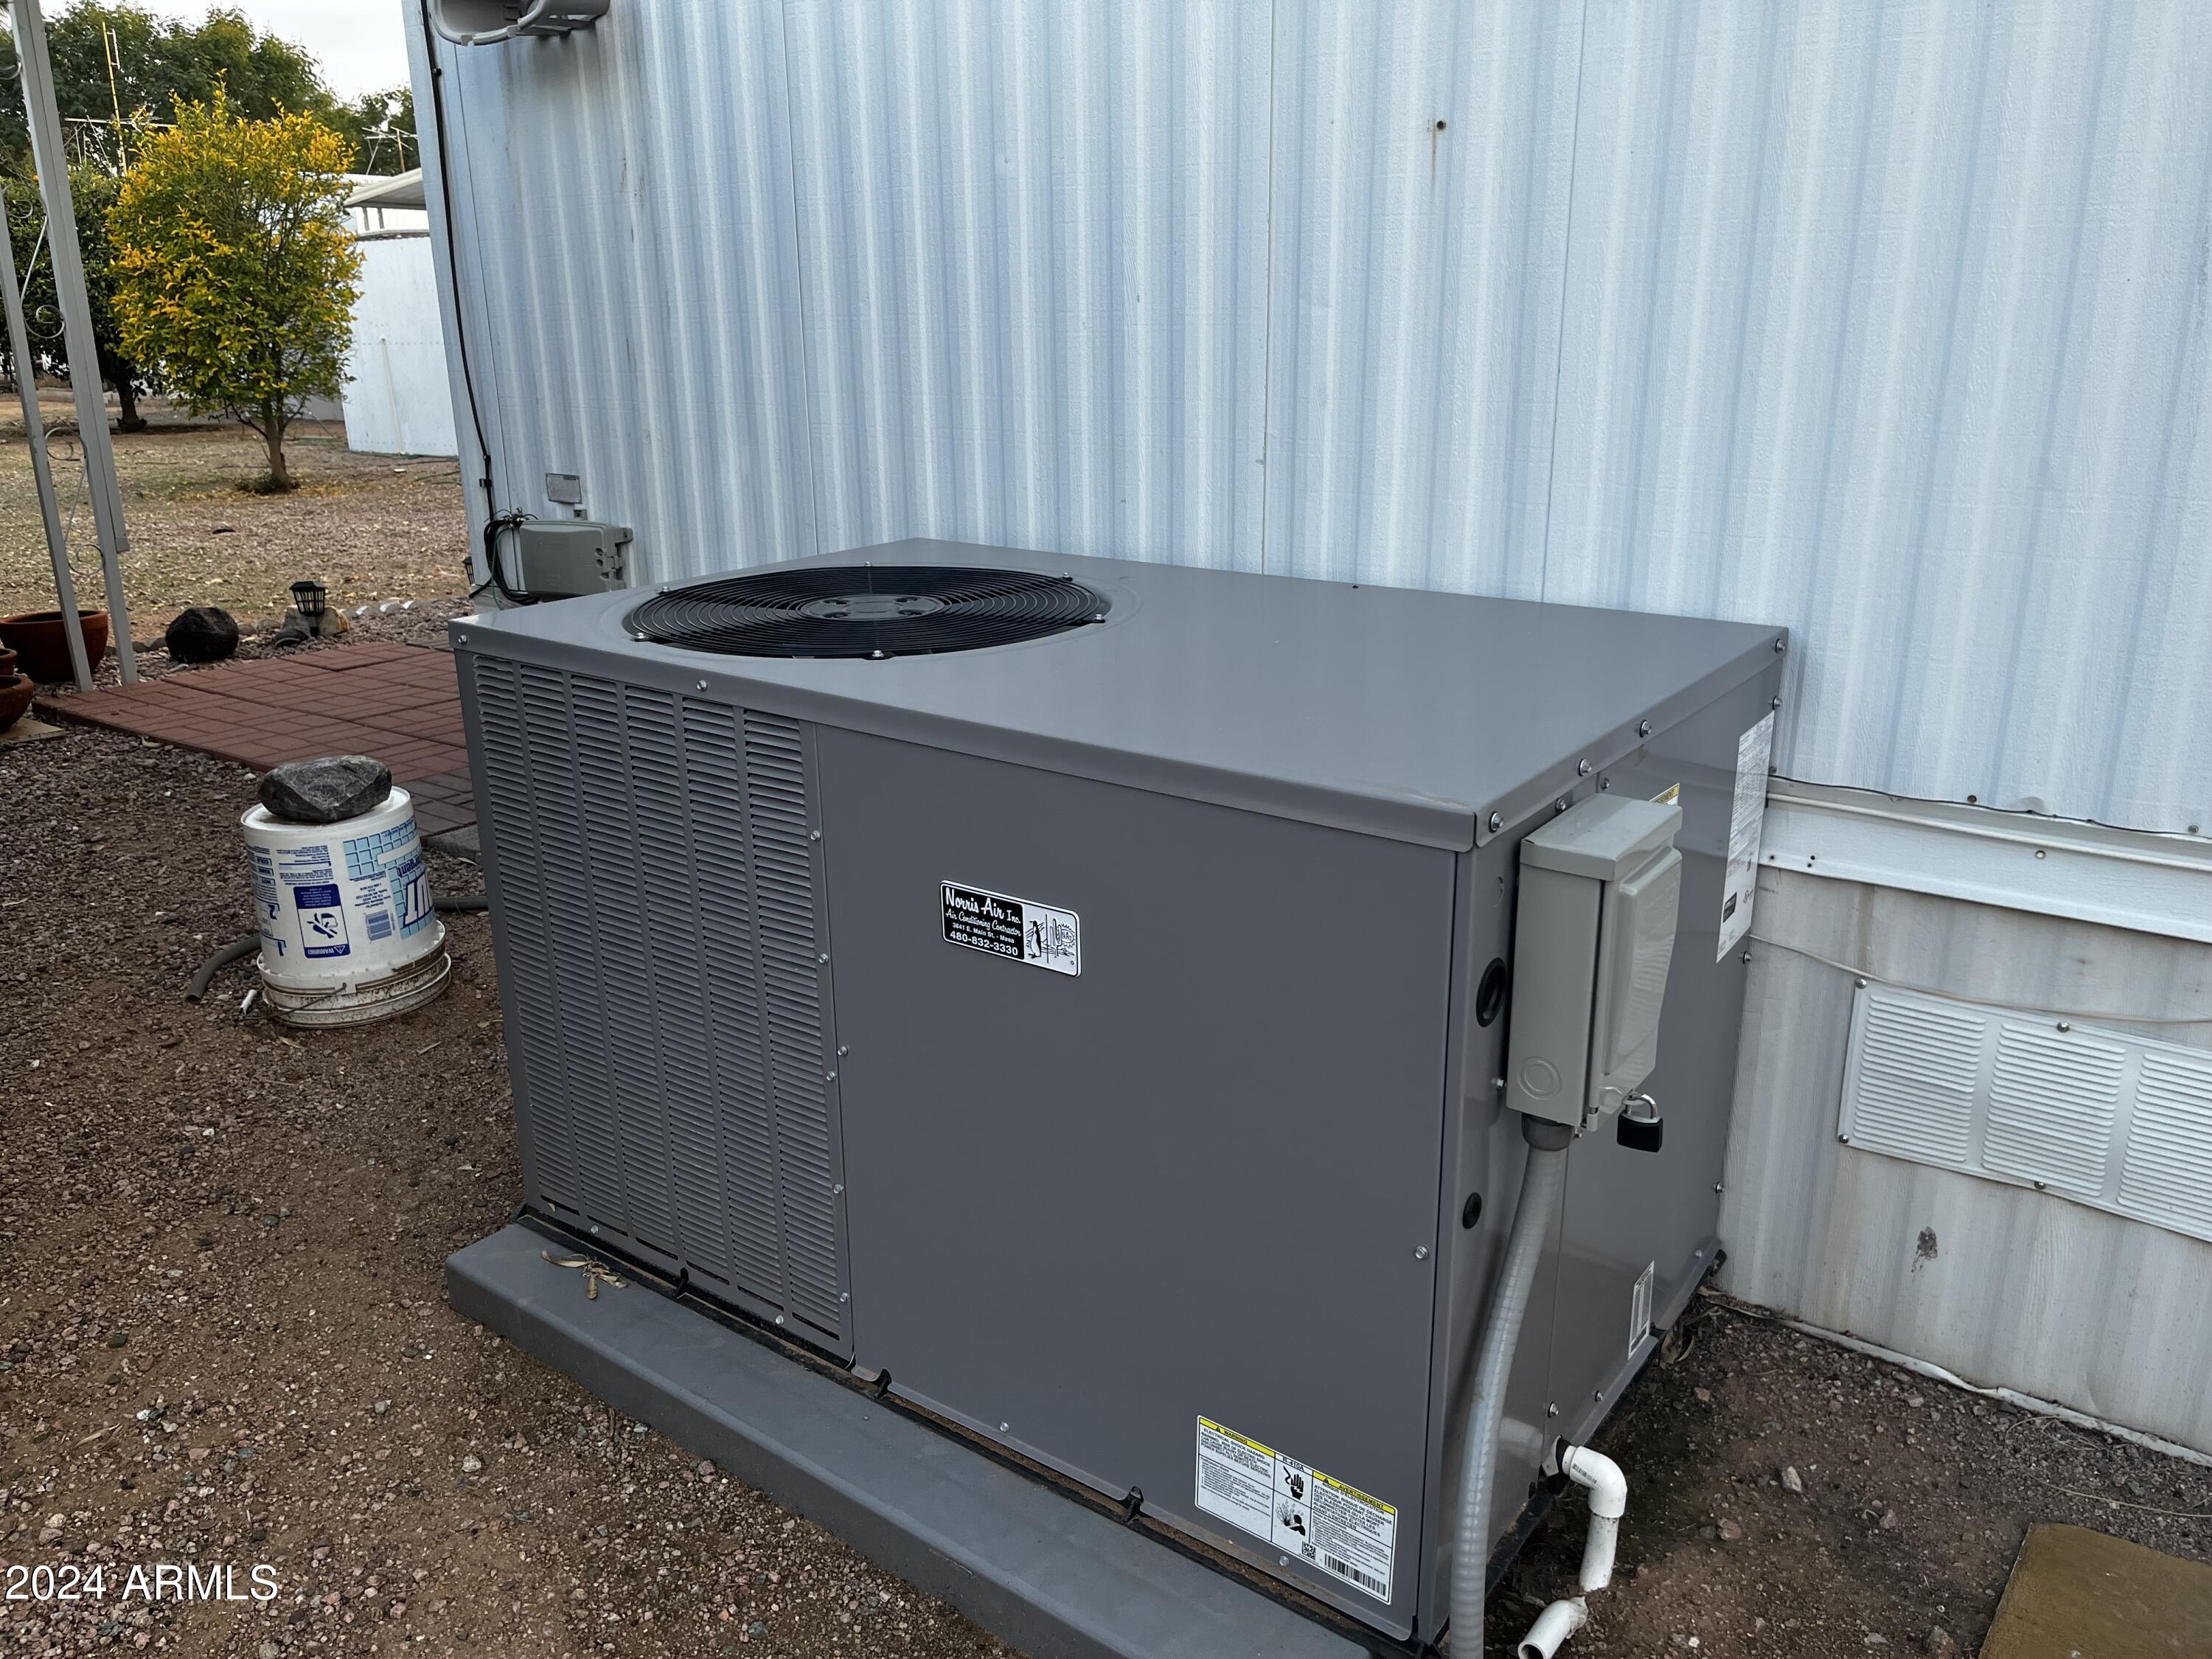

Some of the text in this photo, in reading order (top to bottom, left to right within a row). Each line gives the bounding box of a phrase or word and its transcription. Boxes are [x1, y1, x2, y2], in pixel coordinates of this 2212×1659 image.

[946, 887, 1020, 923] Norris Air Inc.
[945, 908, 1021, 936] Air Conditioning Contractor
[973, 927, 987, 936] Main
[950, 931, 1018, 956] 480-832-3330
[1224, 1430, 1247, 1444] WARNING
[1282, 1457, 1304, 1472] R-410A
[1338, 1484, 1383, 1509] AVERTISSEMENT
